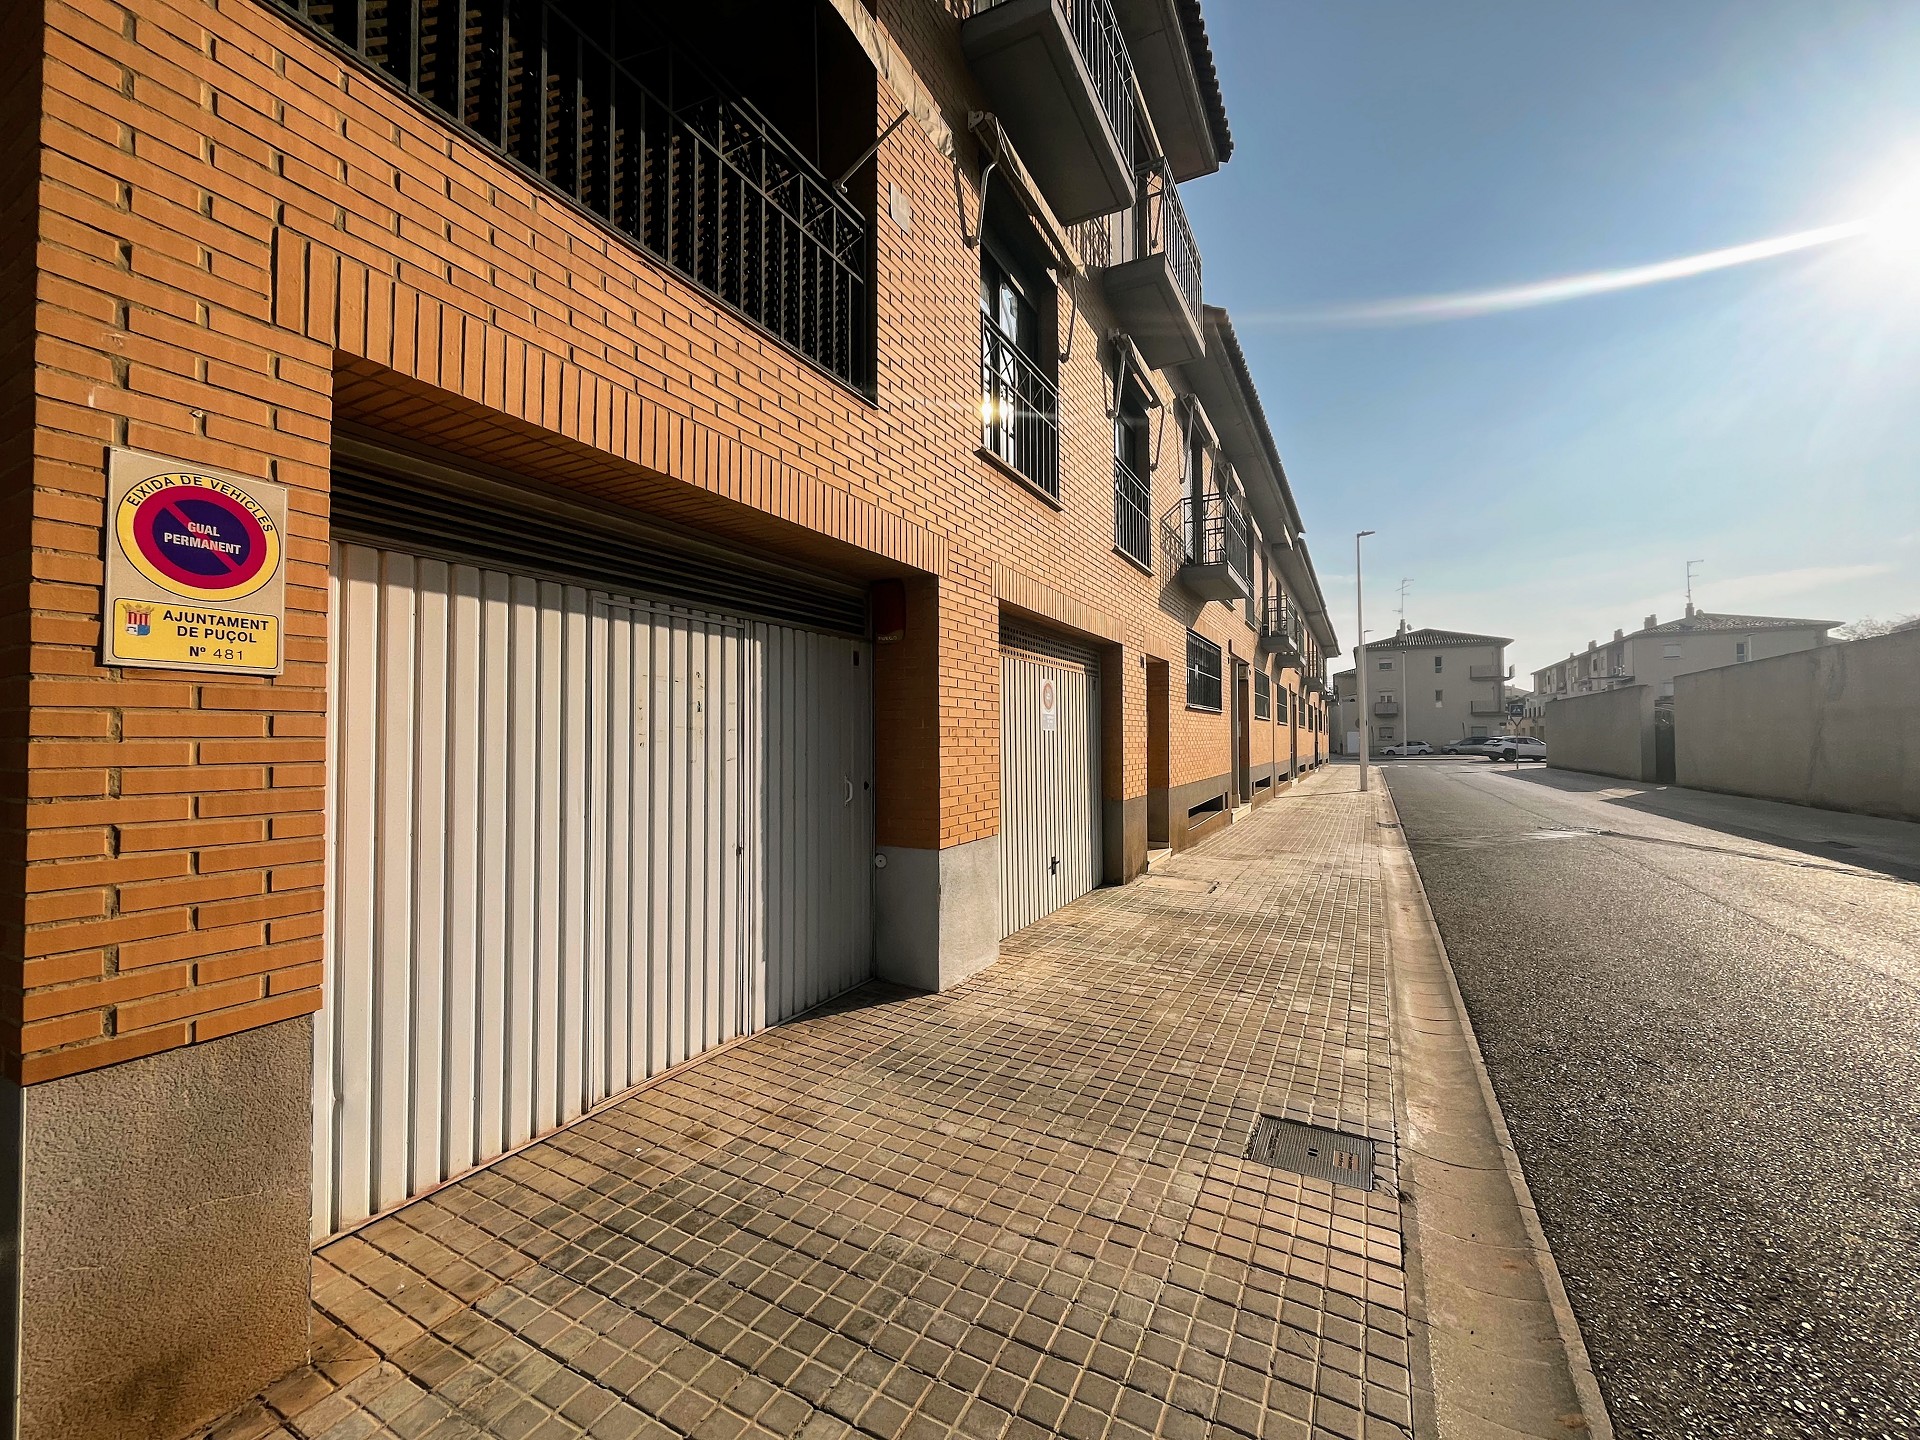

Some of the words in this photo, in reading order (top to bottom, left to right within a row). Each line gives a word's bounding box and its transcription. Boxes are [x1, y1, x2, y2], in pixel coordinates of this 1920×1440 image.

[127, 476, 175, 507] EIXIDA
[179, 475, 203, 486] DE
[210, 479, 273, 532] VEHICLES
[187, 521, 220, 537] GUAL
[164, 532, 242, 555] PERMANENT
[163, 610, 269, 631] AJUNTAMENT
[177, 625, 199, 638] DE
[204, 628, 257, 643] PUÇOL
[213, 648, 244, 661] 481
